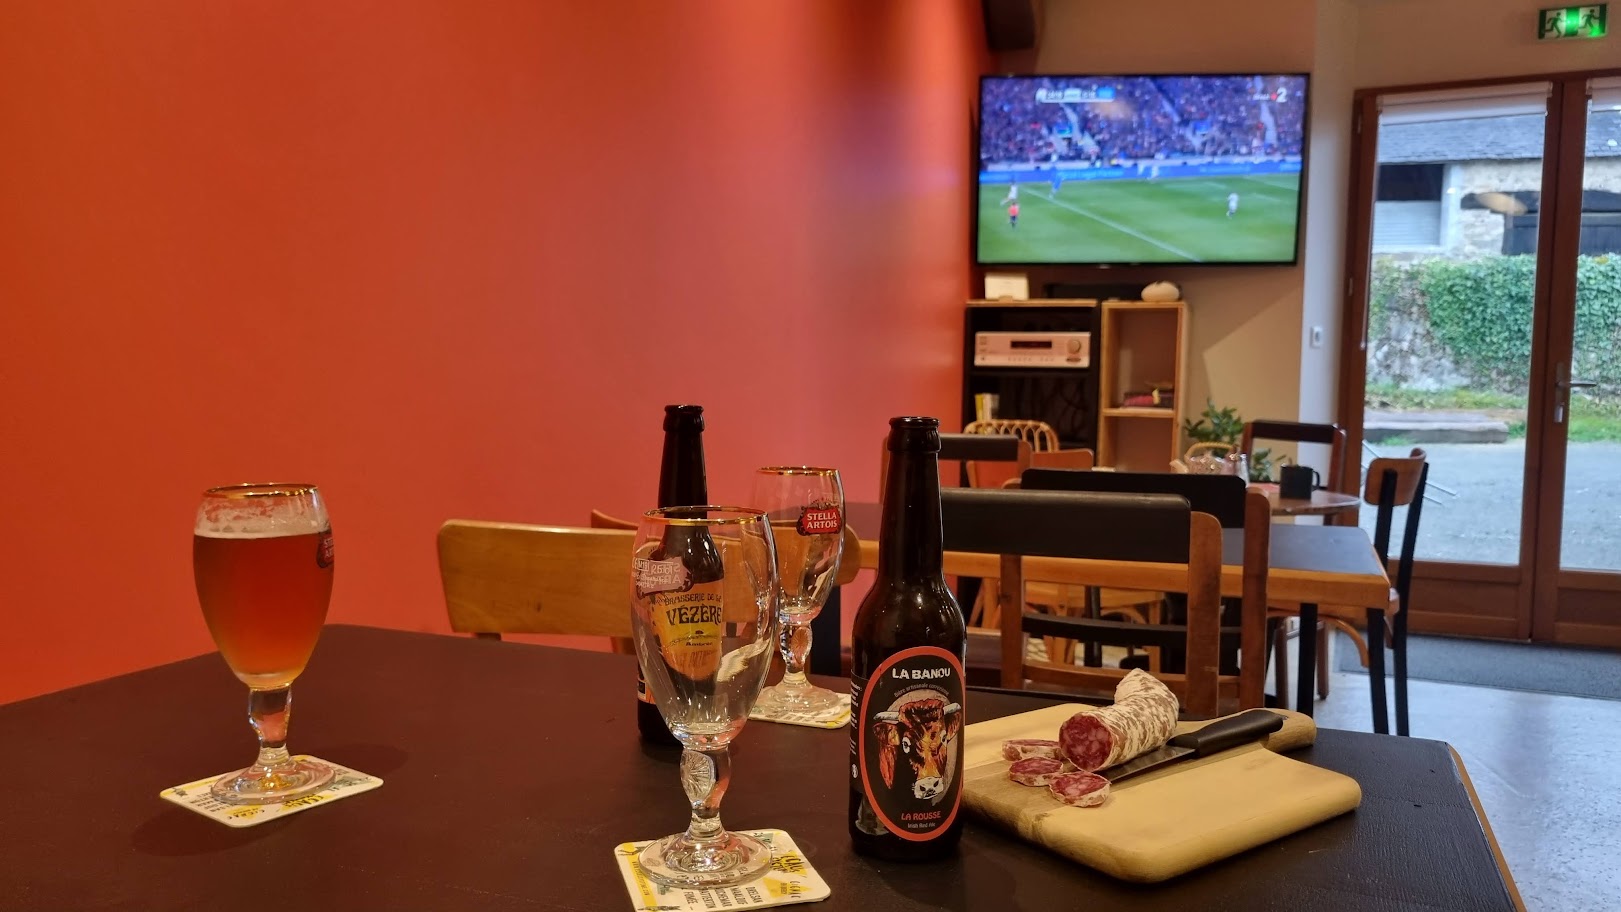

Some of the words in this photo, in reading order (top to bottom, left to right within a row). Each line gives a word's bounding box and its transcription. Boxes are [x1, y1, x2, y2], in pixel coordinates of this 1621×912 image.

[1276, 87, 1287, 103] 2
[807, 512, 837, 521] STELLA
[806, 520, 838, 529] ARTOIS
[665, 603, 722, 626] VÉZÈRE
[892, 667, 910, 680] LA
[911, 667, 951, 680] BANOU
[901, 812, 912, 821] LA
[912, 810, 942, 821] ROUSSE
